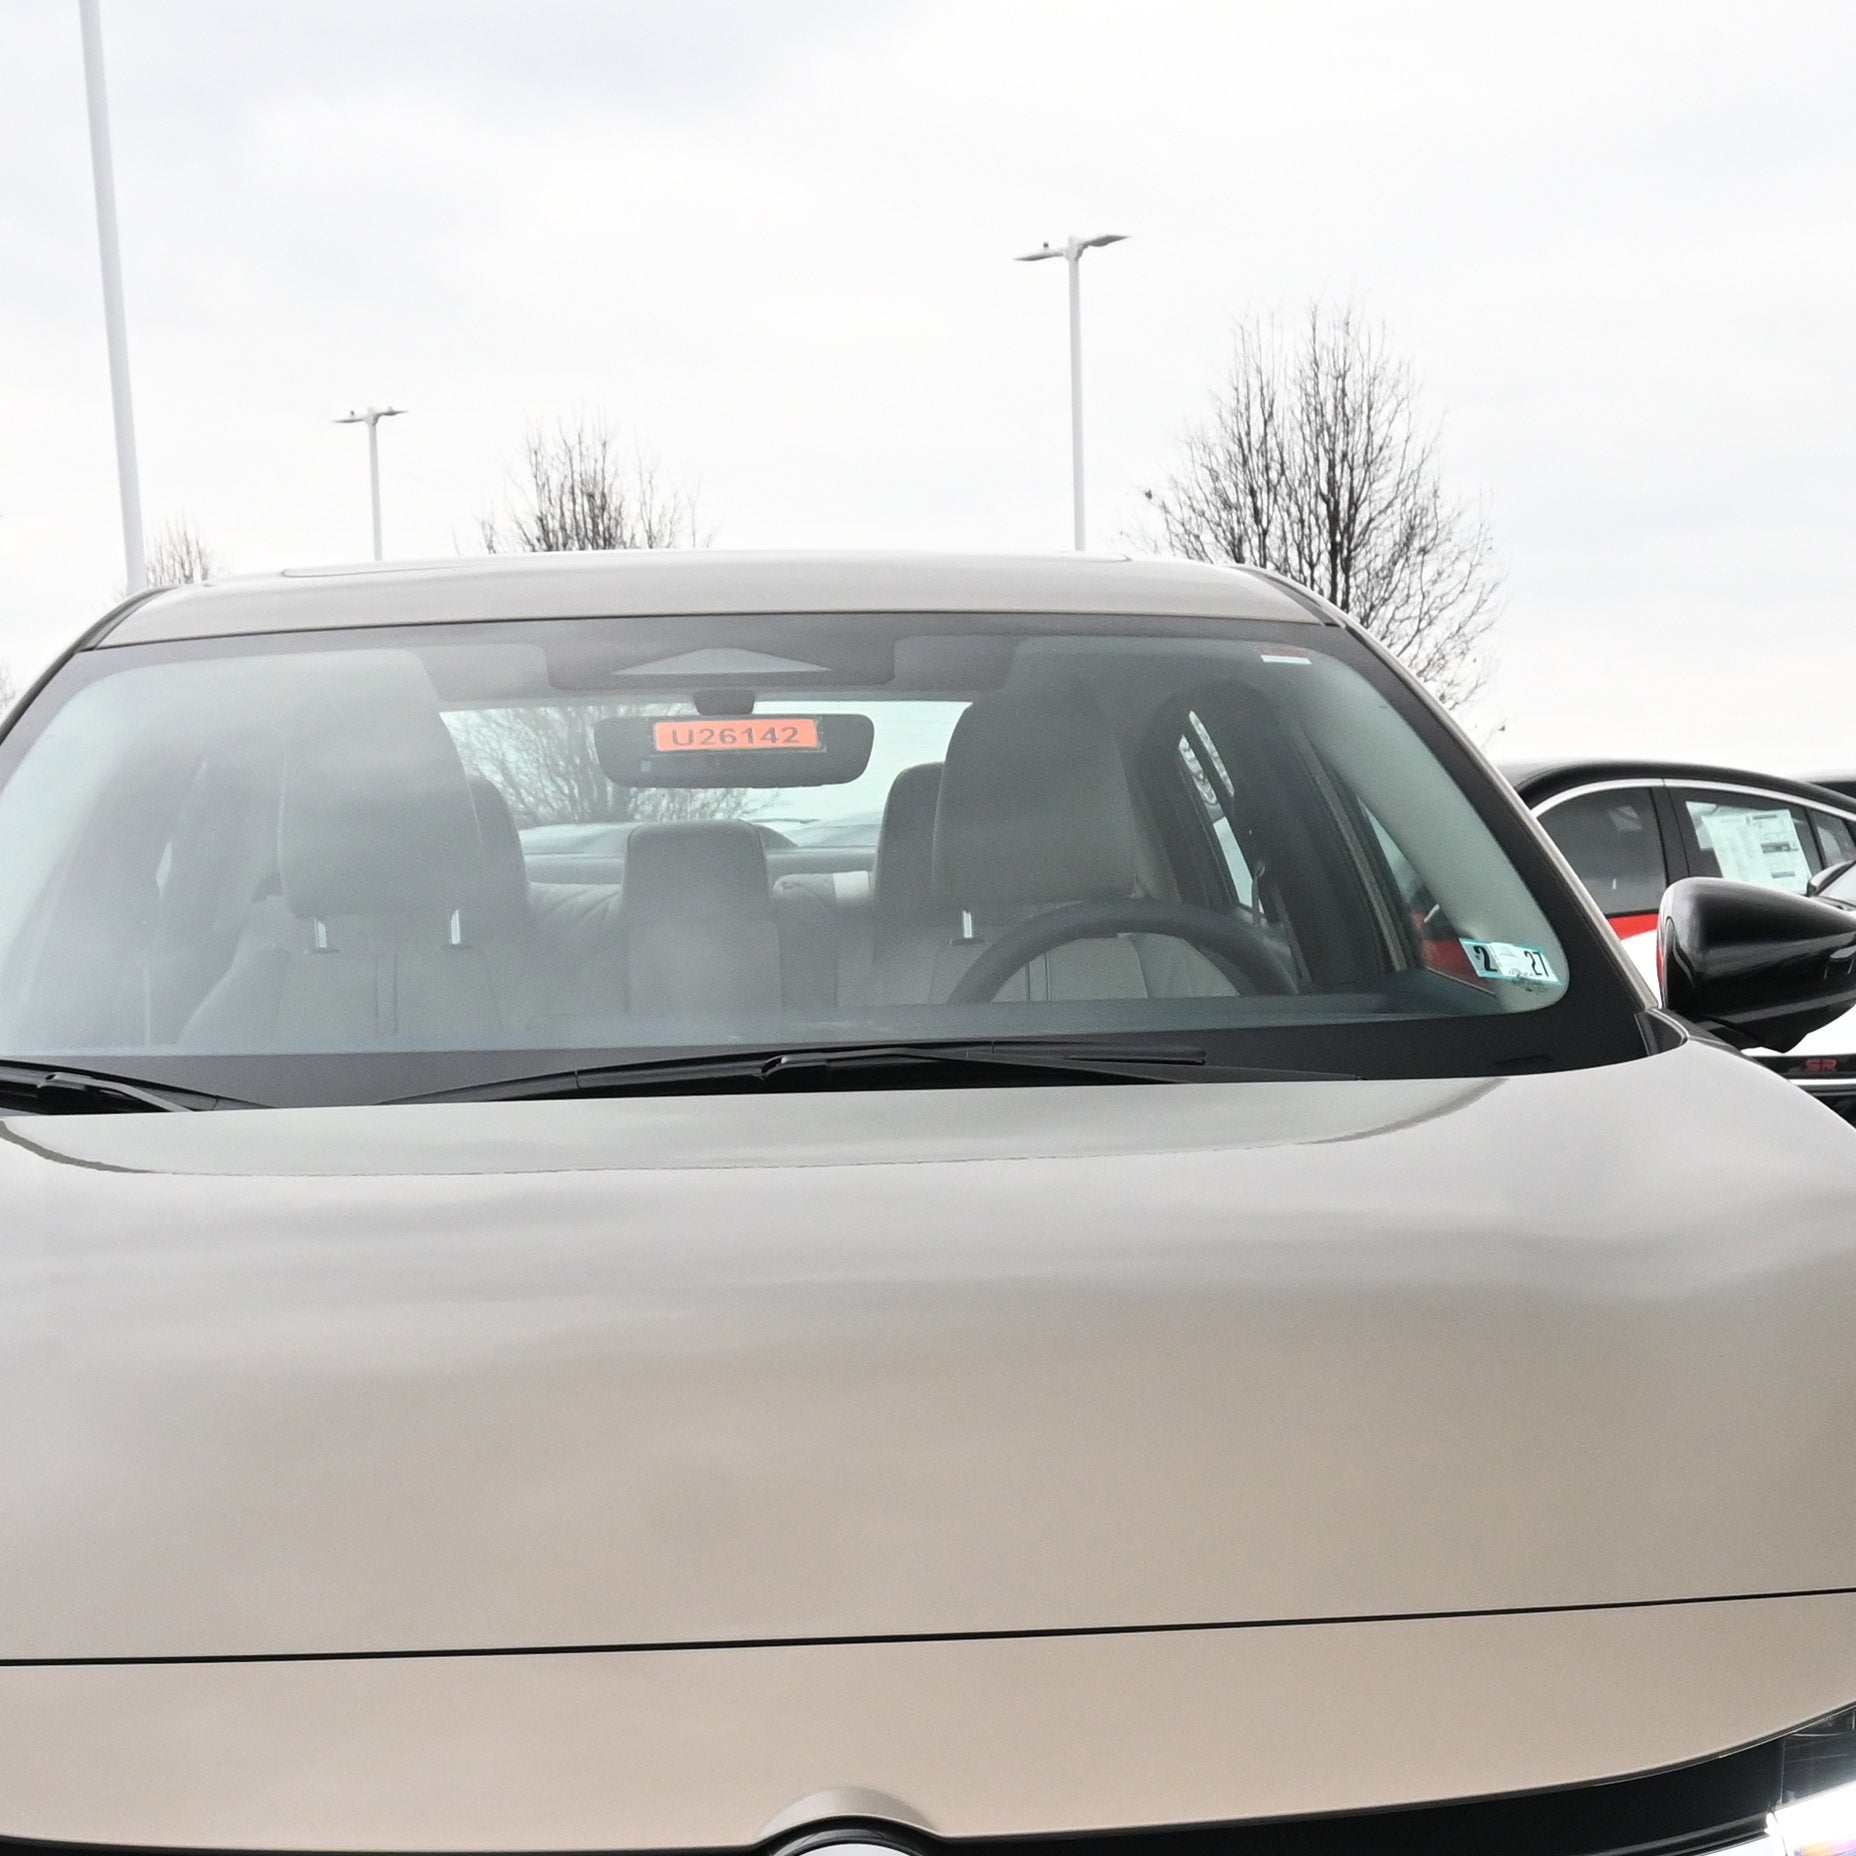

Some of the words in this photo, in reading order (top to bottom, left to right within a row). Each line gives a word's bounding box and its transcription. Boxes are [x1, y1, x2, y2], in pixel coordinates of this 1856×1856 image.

[672, 726, 799, 746] U26142
[1473, 945, 1498, 972] 2
[1524, 950, 1549, 977] 27
[1806, 1058, 1837, 1071] SR
